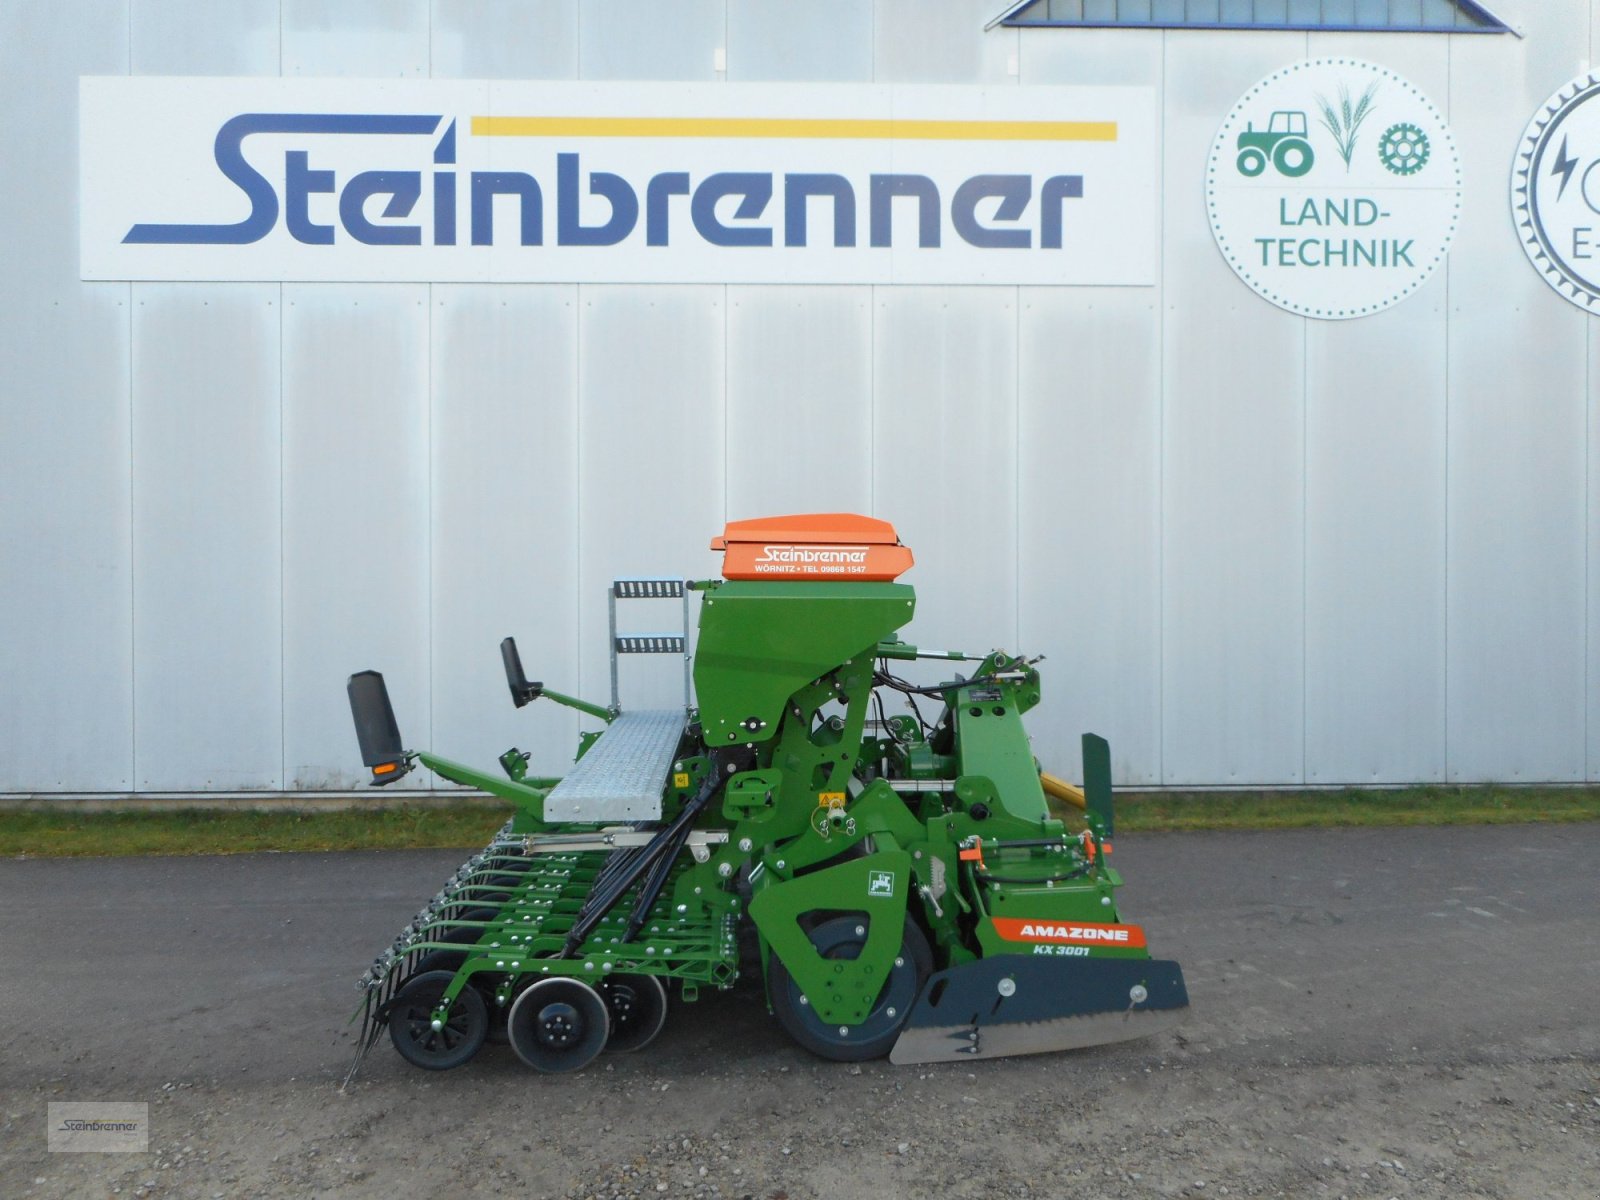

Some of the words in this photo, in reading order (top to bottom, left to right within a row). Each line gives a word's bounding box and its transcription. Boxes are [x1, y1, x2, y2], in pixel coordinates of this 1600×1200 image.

[120, 113, 1084, 247] Steinbrenner
[1279, 197, 1391, 227] LAND-
[1254, 238, 1415, 268] TECHNIK
[754, 545, 867, 563] Steinbrenner
[754, 563, 796, 573] WÖRNITZ
[802, 565, 819, 573] TEL
[847, 565, 866, 573] 1547
[1020, 924, 1129, 941] AMAZONE
[1033, 944, 1055, 955] KX
[1055, 945, 1091, 957] 3001
